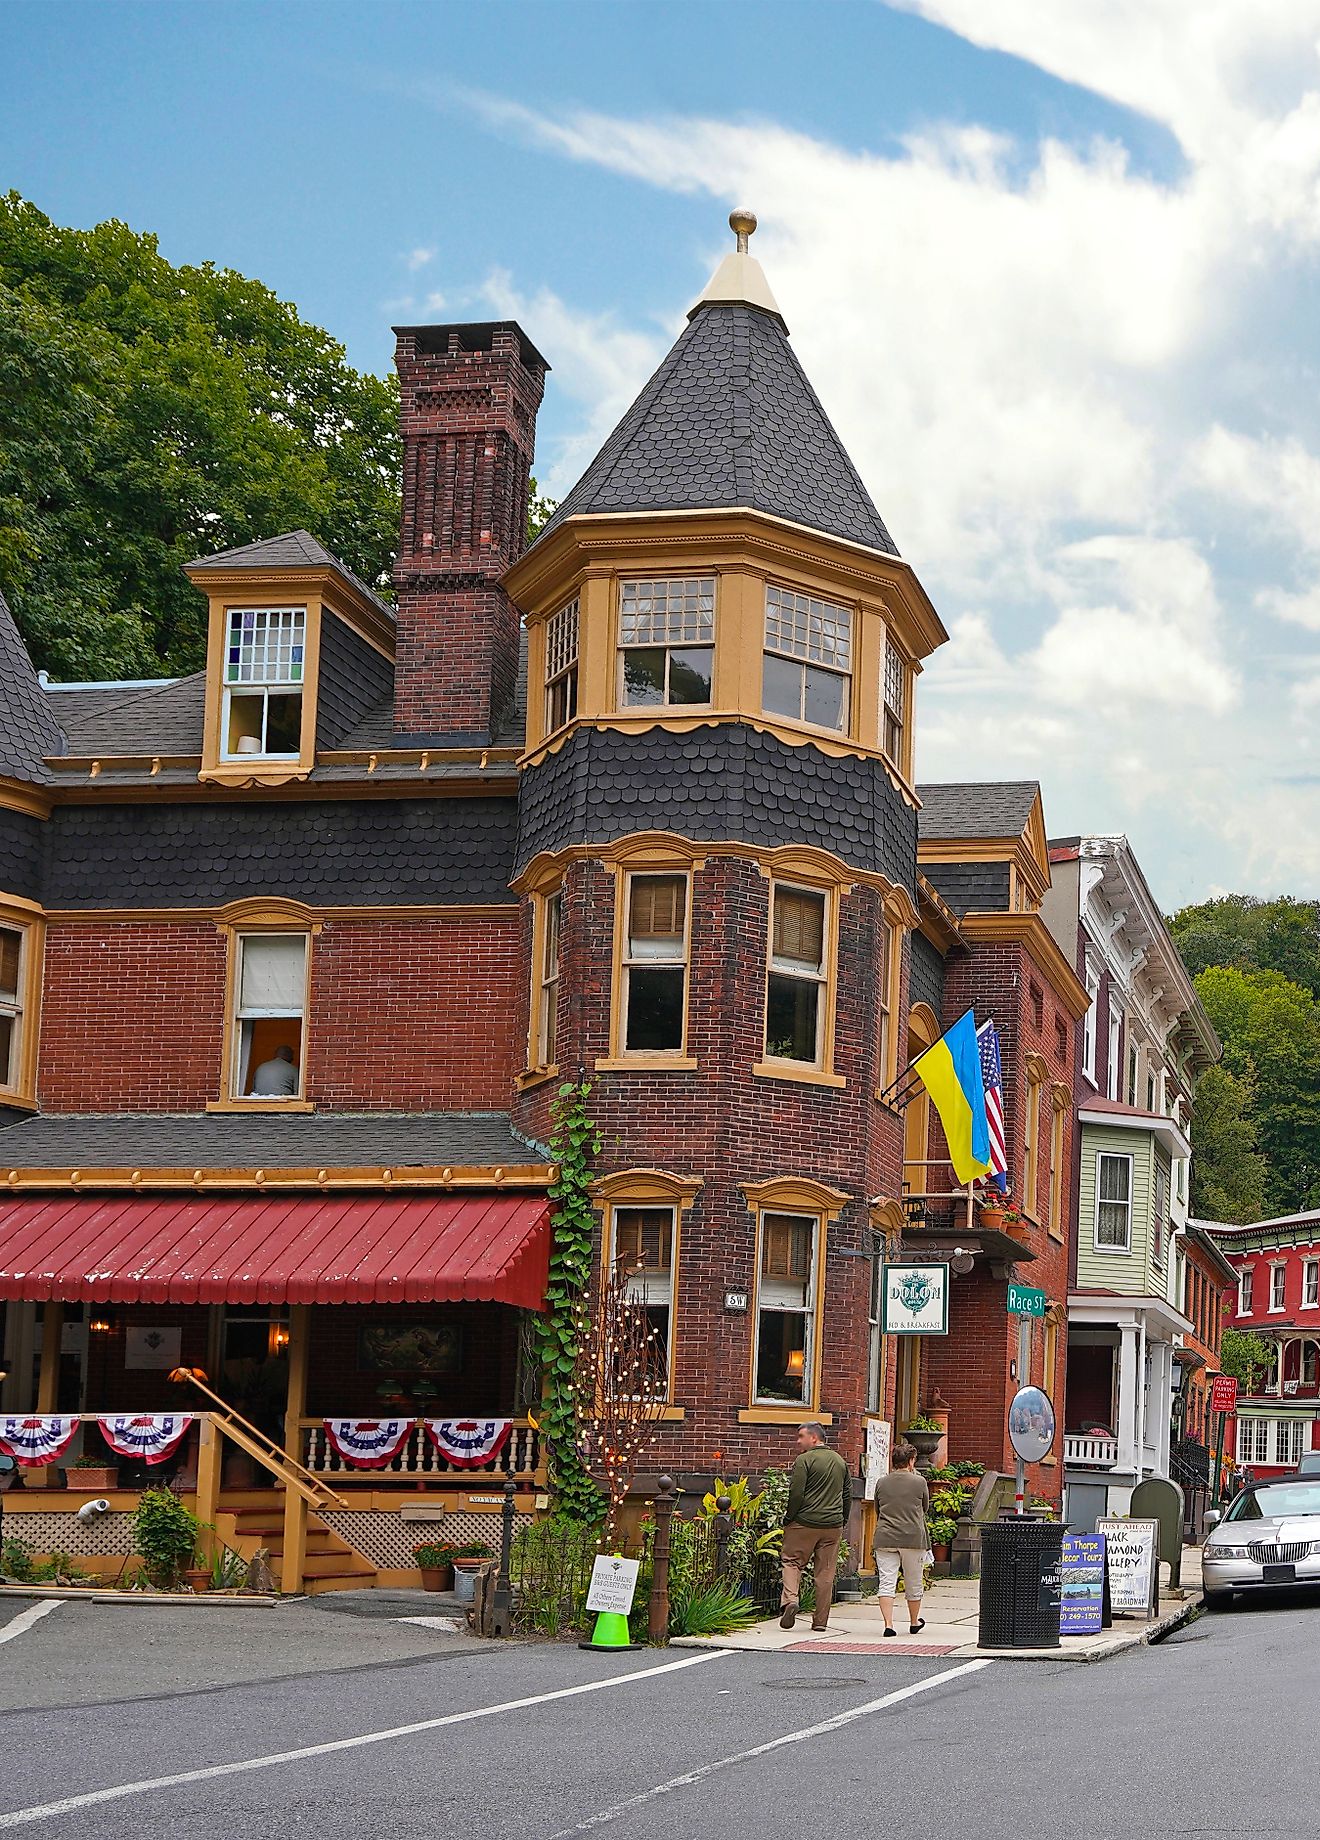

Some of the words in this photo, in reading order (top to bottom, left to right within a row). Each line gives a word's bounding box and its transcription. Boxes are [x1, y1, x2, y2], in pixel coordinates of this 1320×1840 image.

[889, 1286, 941, 1300] DOLON
[1009, 1288, 1033, 1311] Race
[1034, 1295, 1043, 1309] ST
[906, 1321, 941, 1329] BREAKFAST
[1102, 1531, 1129, 1542] LACK
[1062, 1540, 1072, 1550] im
[1073, 1539, 1099, 1552] Thorpe
[1068, 1612, 1101, 1620] 249-1570
